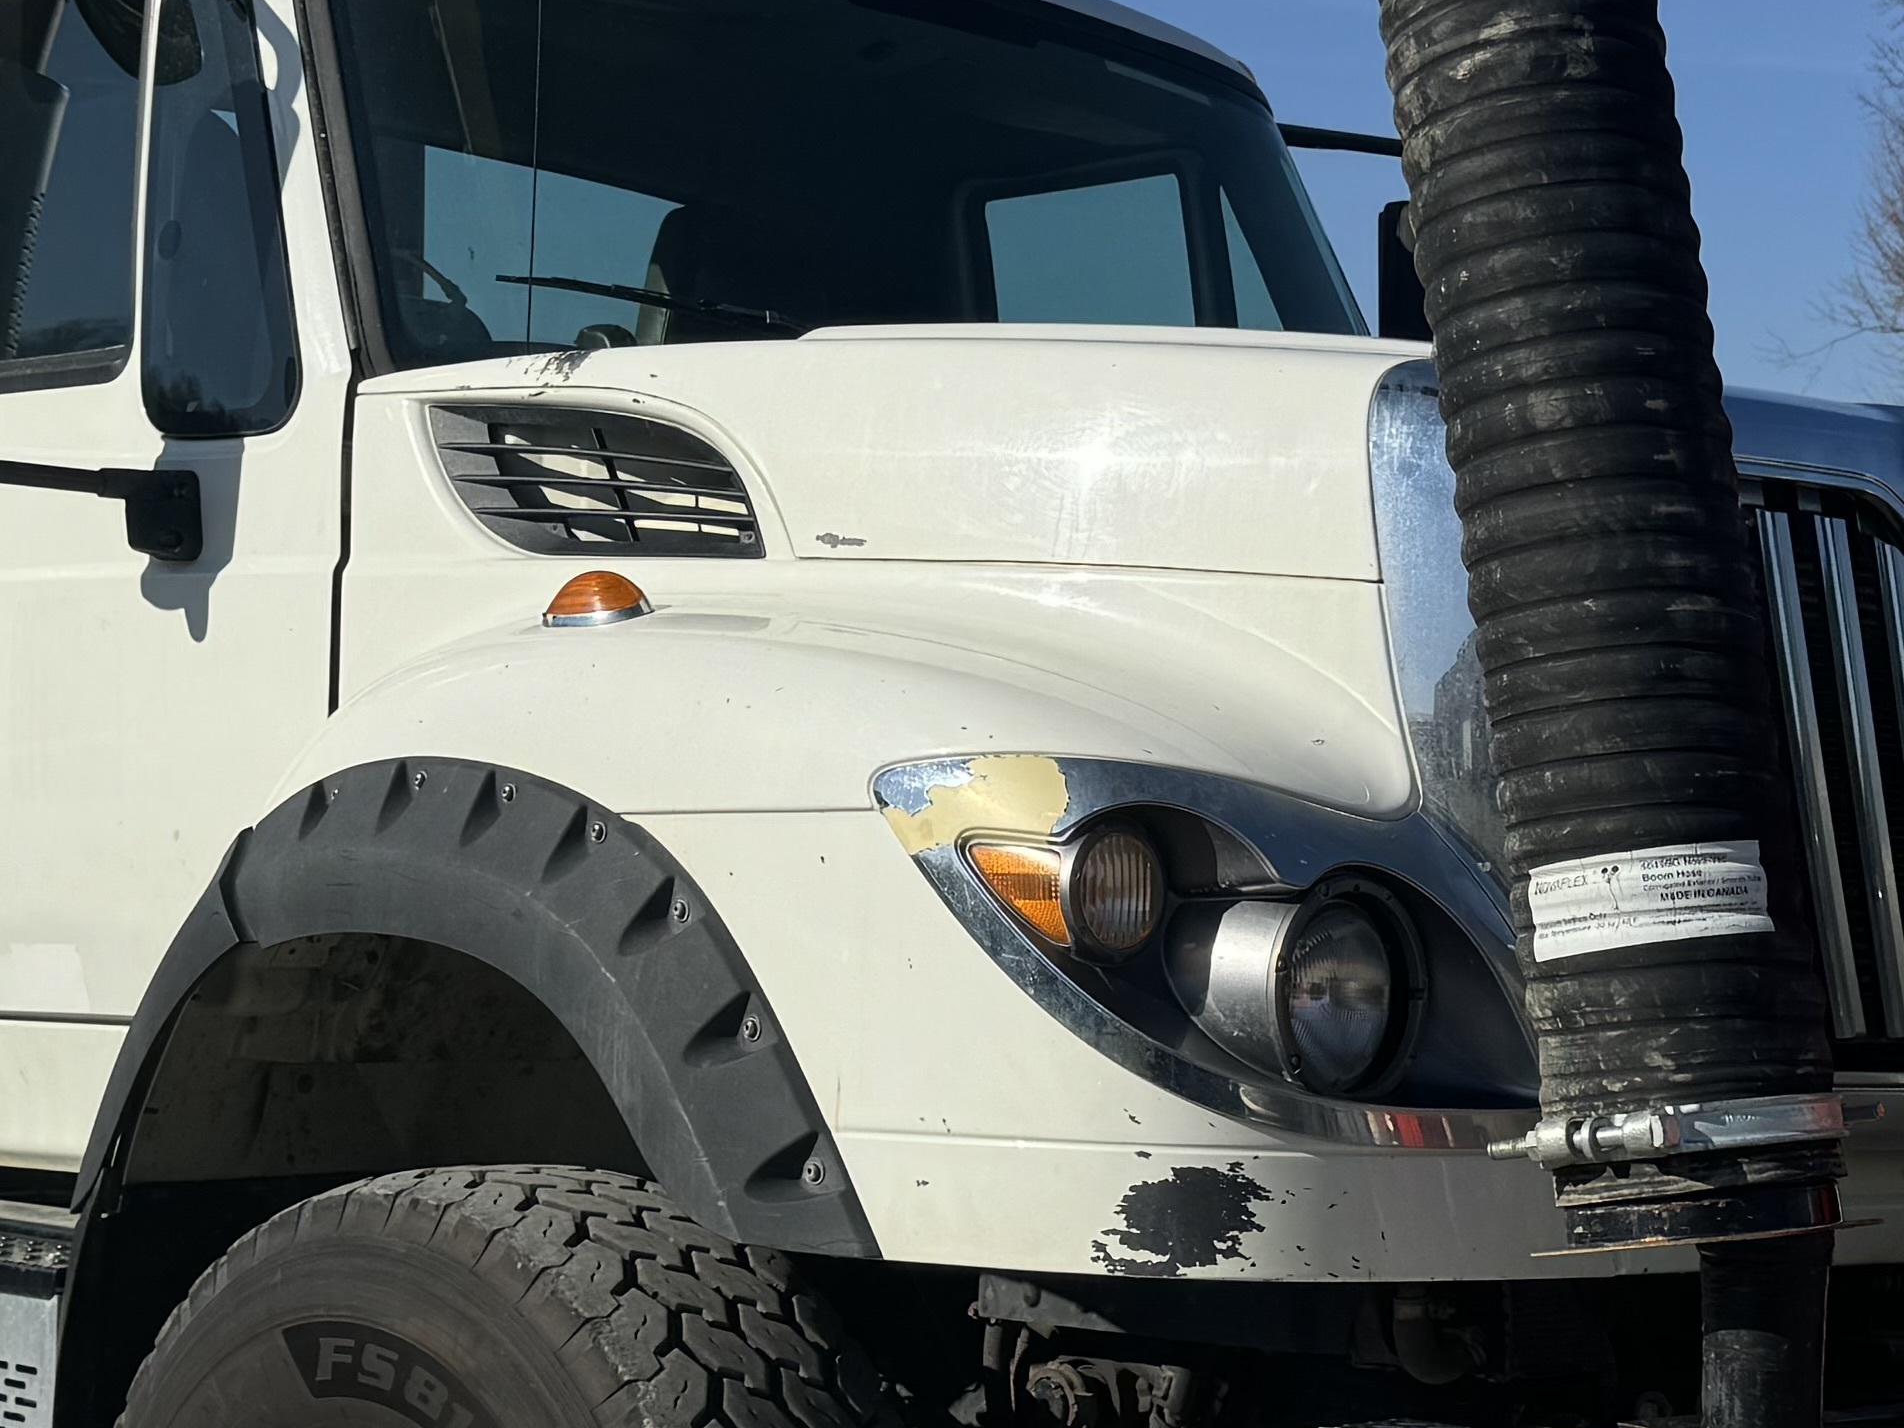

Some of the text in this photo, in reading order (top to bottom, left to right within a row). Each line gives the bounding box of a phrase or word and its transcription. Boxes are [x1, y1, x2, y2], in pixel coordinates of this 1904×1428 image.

[1642, 872, 1674, 882] Boom
[1660, 890, 1693, 902] MADE
[1707, 885, 1748, 897] CANADA
